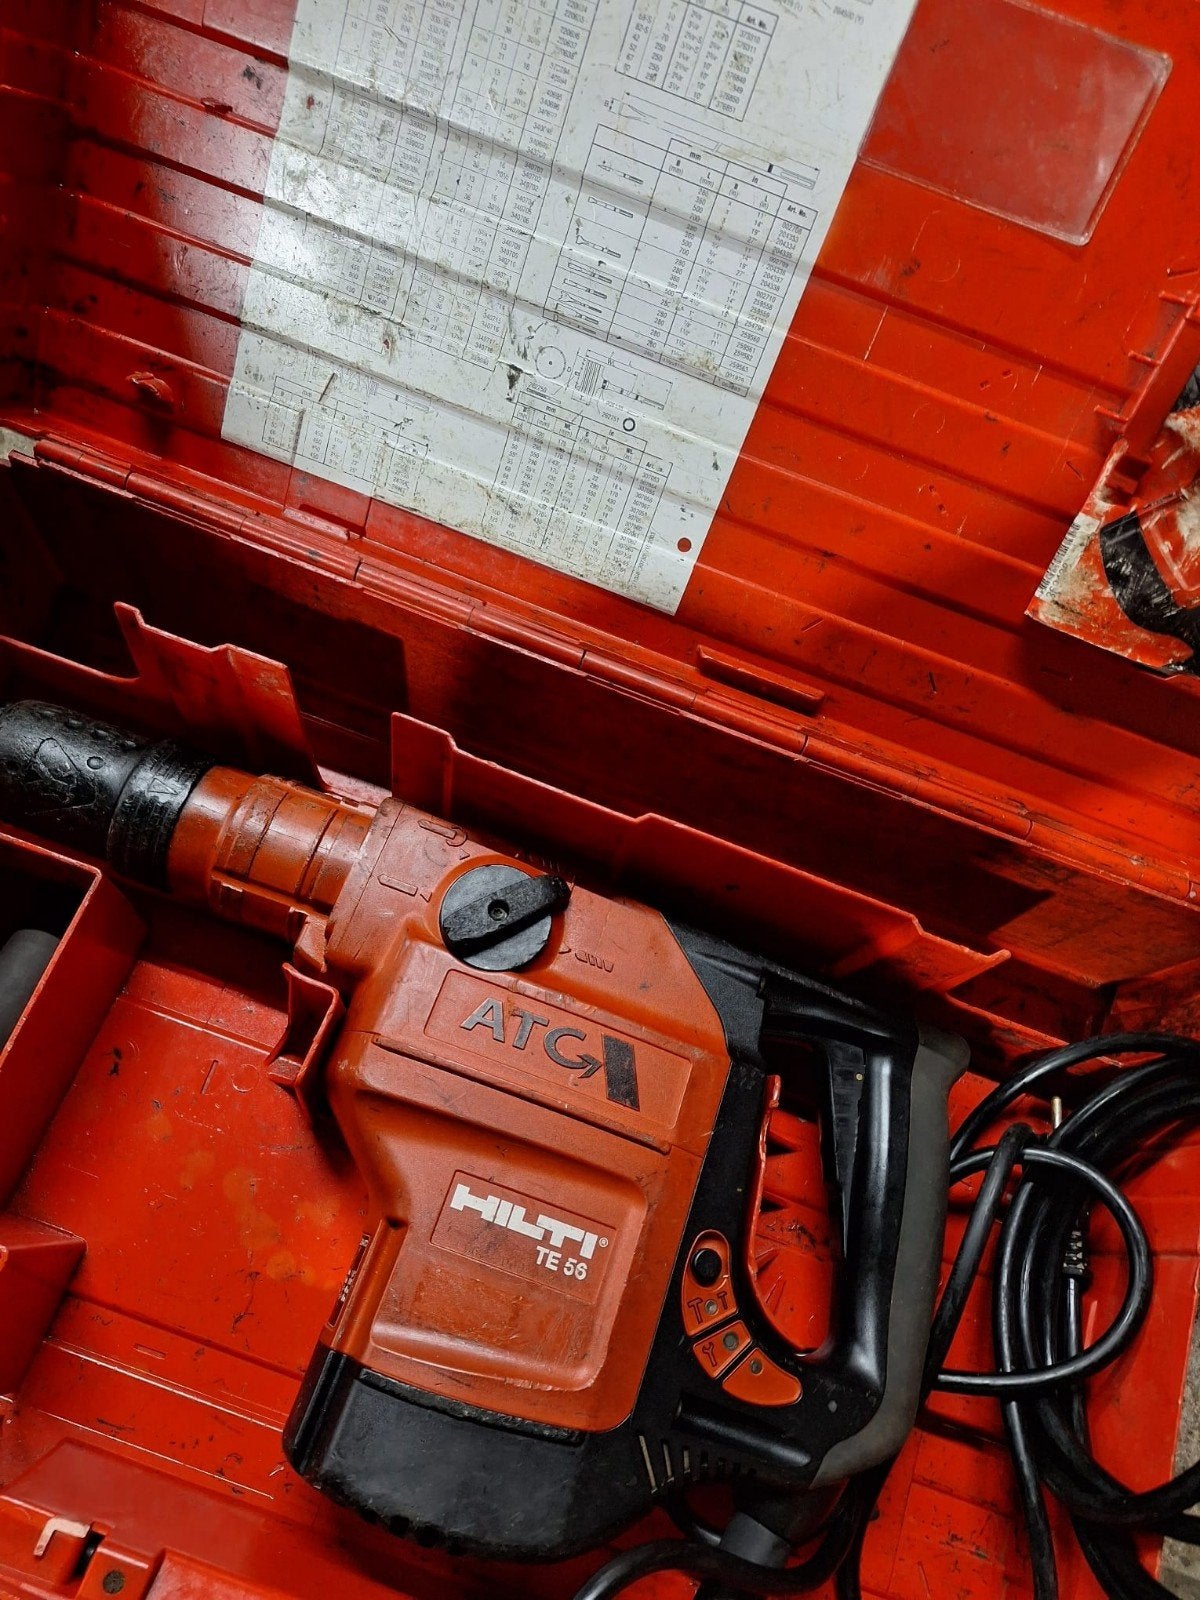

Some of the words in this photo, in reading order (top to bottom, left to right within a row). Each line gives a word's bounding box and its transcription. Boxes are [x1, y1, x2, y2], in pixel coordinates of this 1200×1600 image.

[787, 204, 798, 214] Art.
[461, 997, 604, 1078] ATC
[536, 1246, 562, 1271] TE
[563, 1257, 588, 1281] 56
